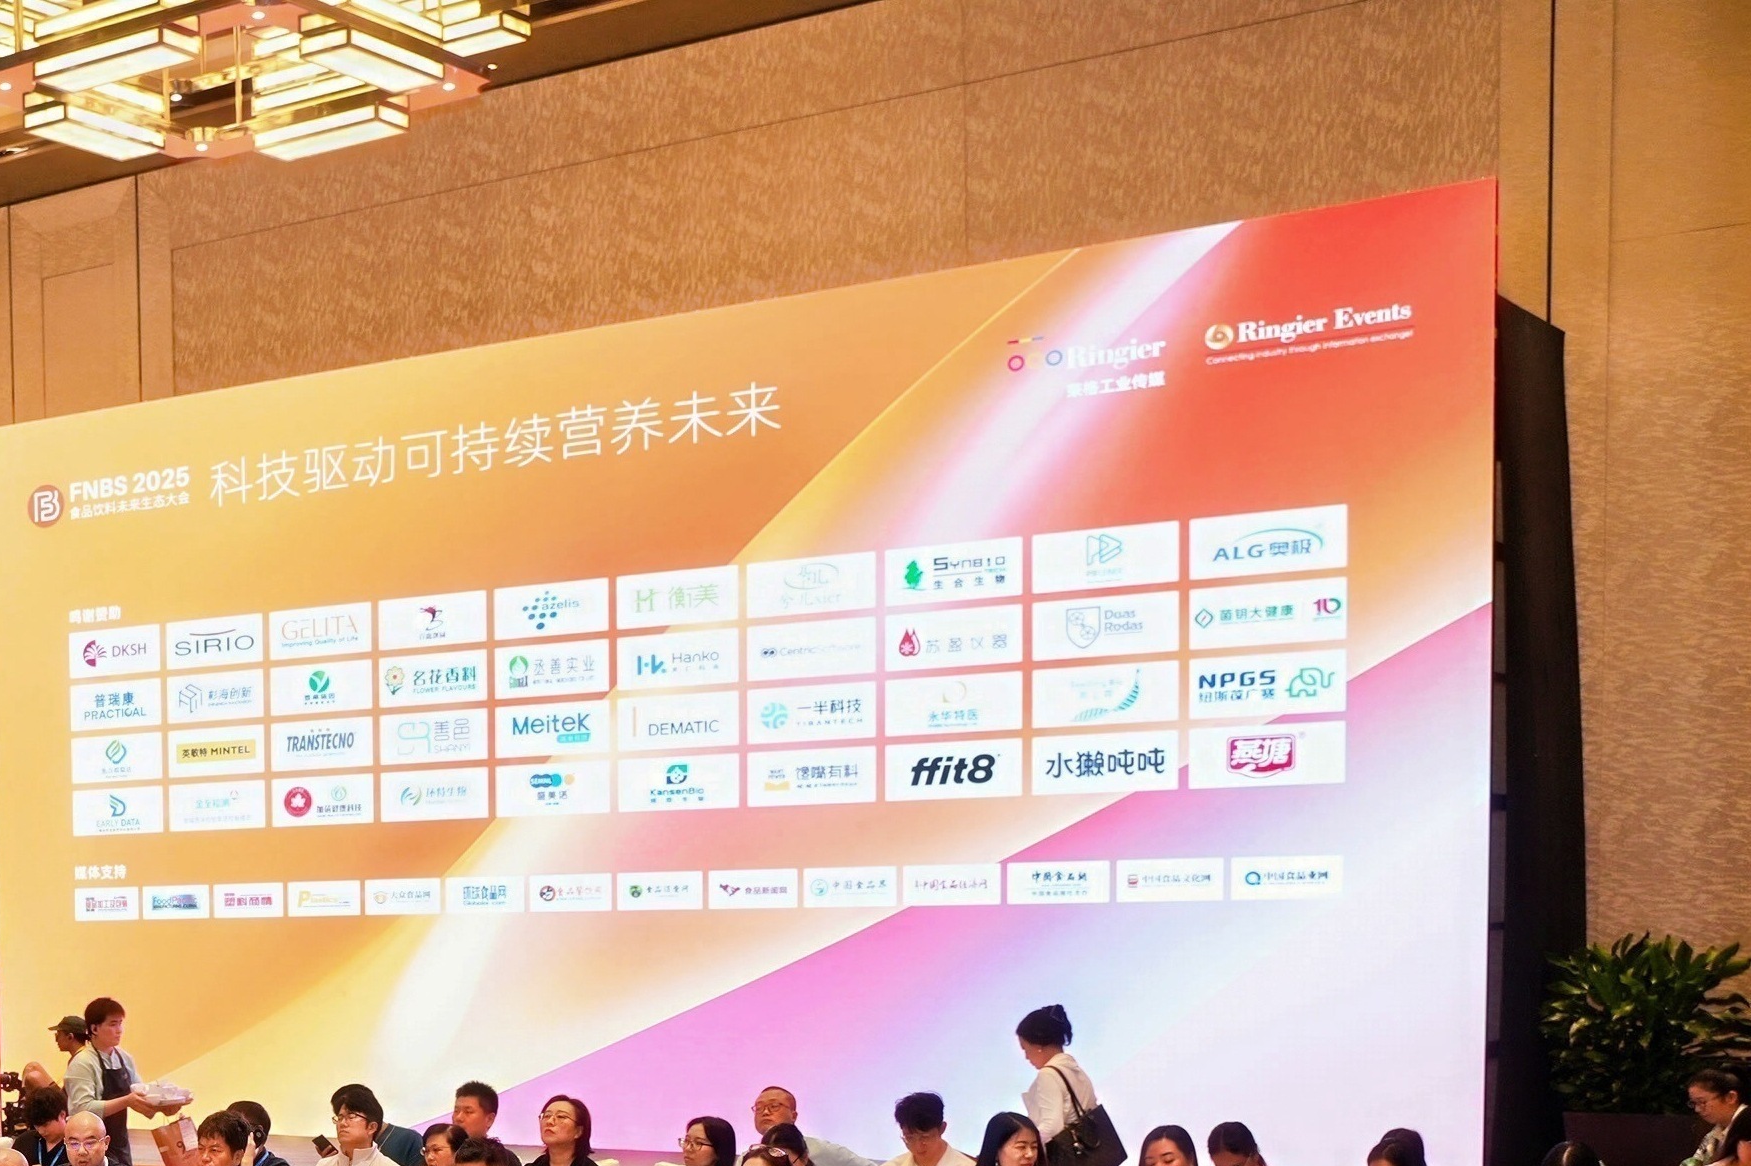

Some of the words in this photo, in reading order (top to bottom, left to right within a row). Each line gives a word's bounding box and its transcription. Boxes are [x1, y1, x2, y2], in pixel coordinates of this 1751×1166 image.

[1237, 315, 1328, 344] Ringier
[1334, 303, 1412, 330] Events
[1067, 338, 1166, 370] Ringier
[210, 381, 781, 507] 科技驱动可持续营养未来
[70, 475, 128, 501] FNBS
[133, 466, 190, 494] 2025
[70, 491, 190, 519] 食品饮料未来生态大会
[1212, 543, 1265, 562] ALG
[933, 574, 1006, 590] 生合生物
[542, 599, 580, 610] azelis
[668, 584, 719, 610] 衡美
[1104, 609, 1135, 620] Duas
[281, 614, 358, 641] GELITA
[1104, 619, 1143, 632] Rodas
[112, 643, 147, 657] DKSH
[175, 635, 255, 657] SIRIO
[672, 651, 719, 663] Hanko
[413, 665, 476, 686] 名花香料
[1199, 669, 1275, 689] NPGS
[413, 686, 439, 694] FLOWER
[442, 684, 476, 692] FLAVOURS
[94, 691, 134, 708] 普瑞康
[797, 698, 862, 715] 一半科技
[84, 706, 146, 721] PRACTICAL
[648, 720, 719, 736] DEMATIC
[286, 732, 354, 752] TRANSTECNO
[434, 743, 471, 753] SHANYI
[182, 748, 207, 758] 英敏特
[211, 745, 250, 756] MINTEL
[1231, 738, 1292, 770] 燕塘
[911, 753, 997, 787] ffit8
[650, 787, 704, 796] KansenBio
[96, 819, 119, 828] EARLY
[121, 818, 140, 827] DATA
[74, 864, 126, 880] 媒体支持
